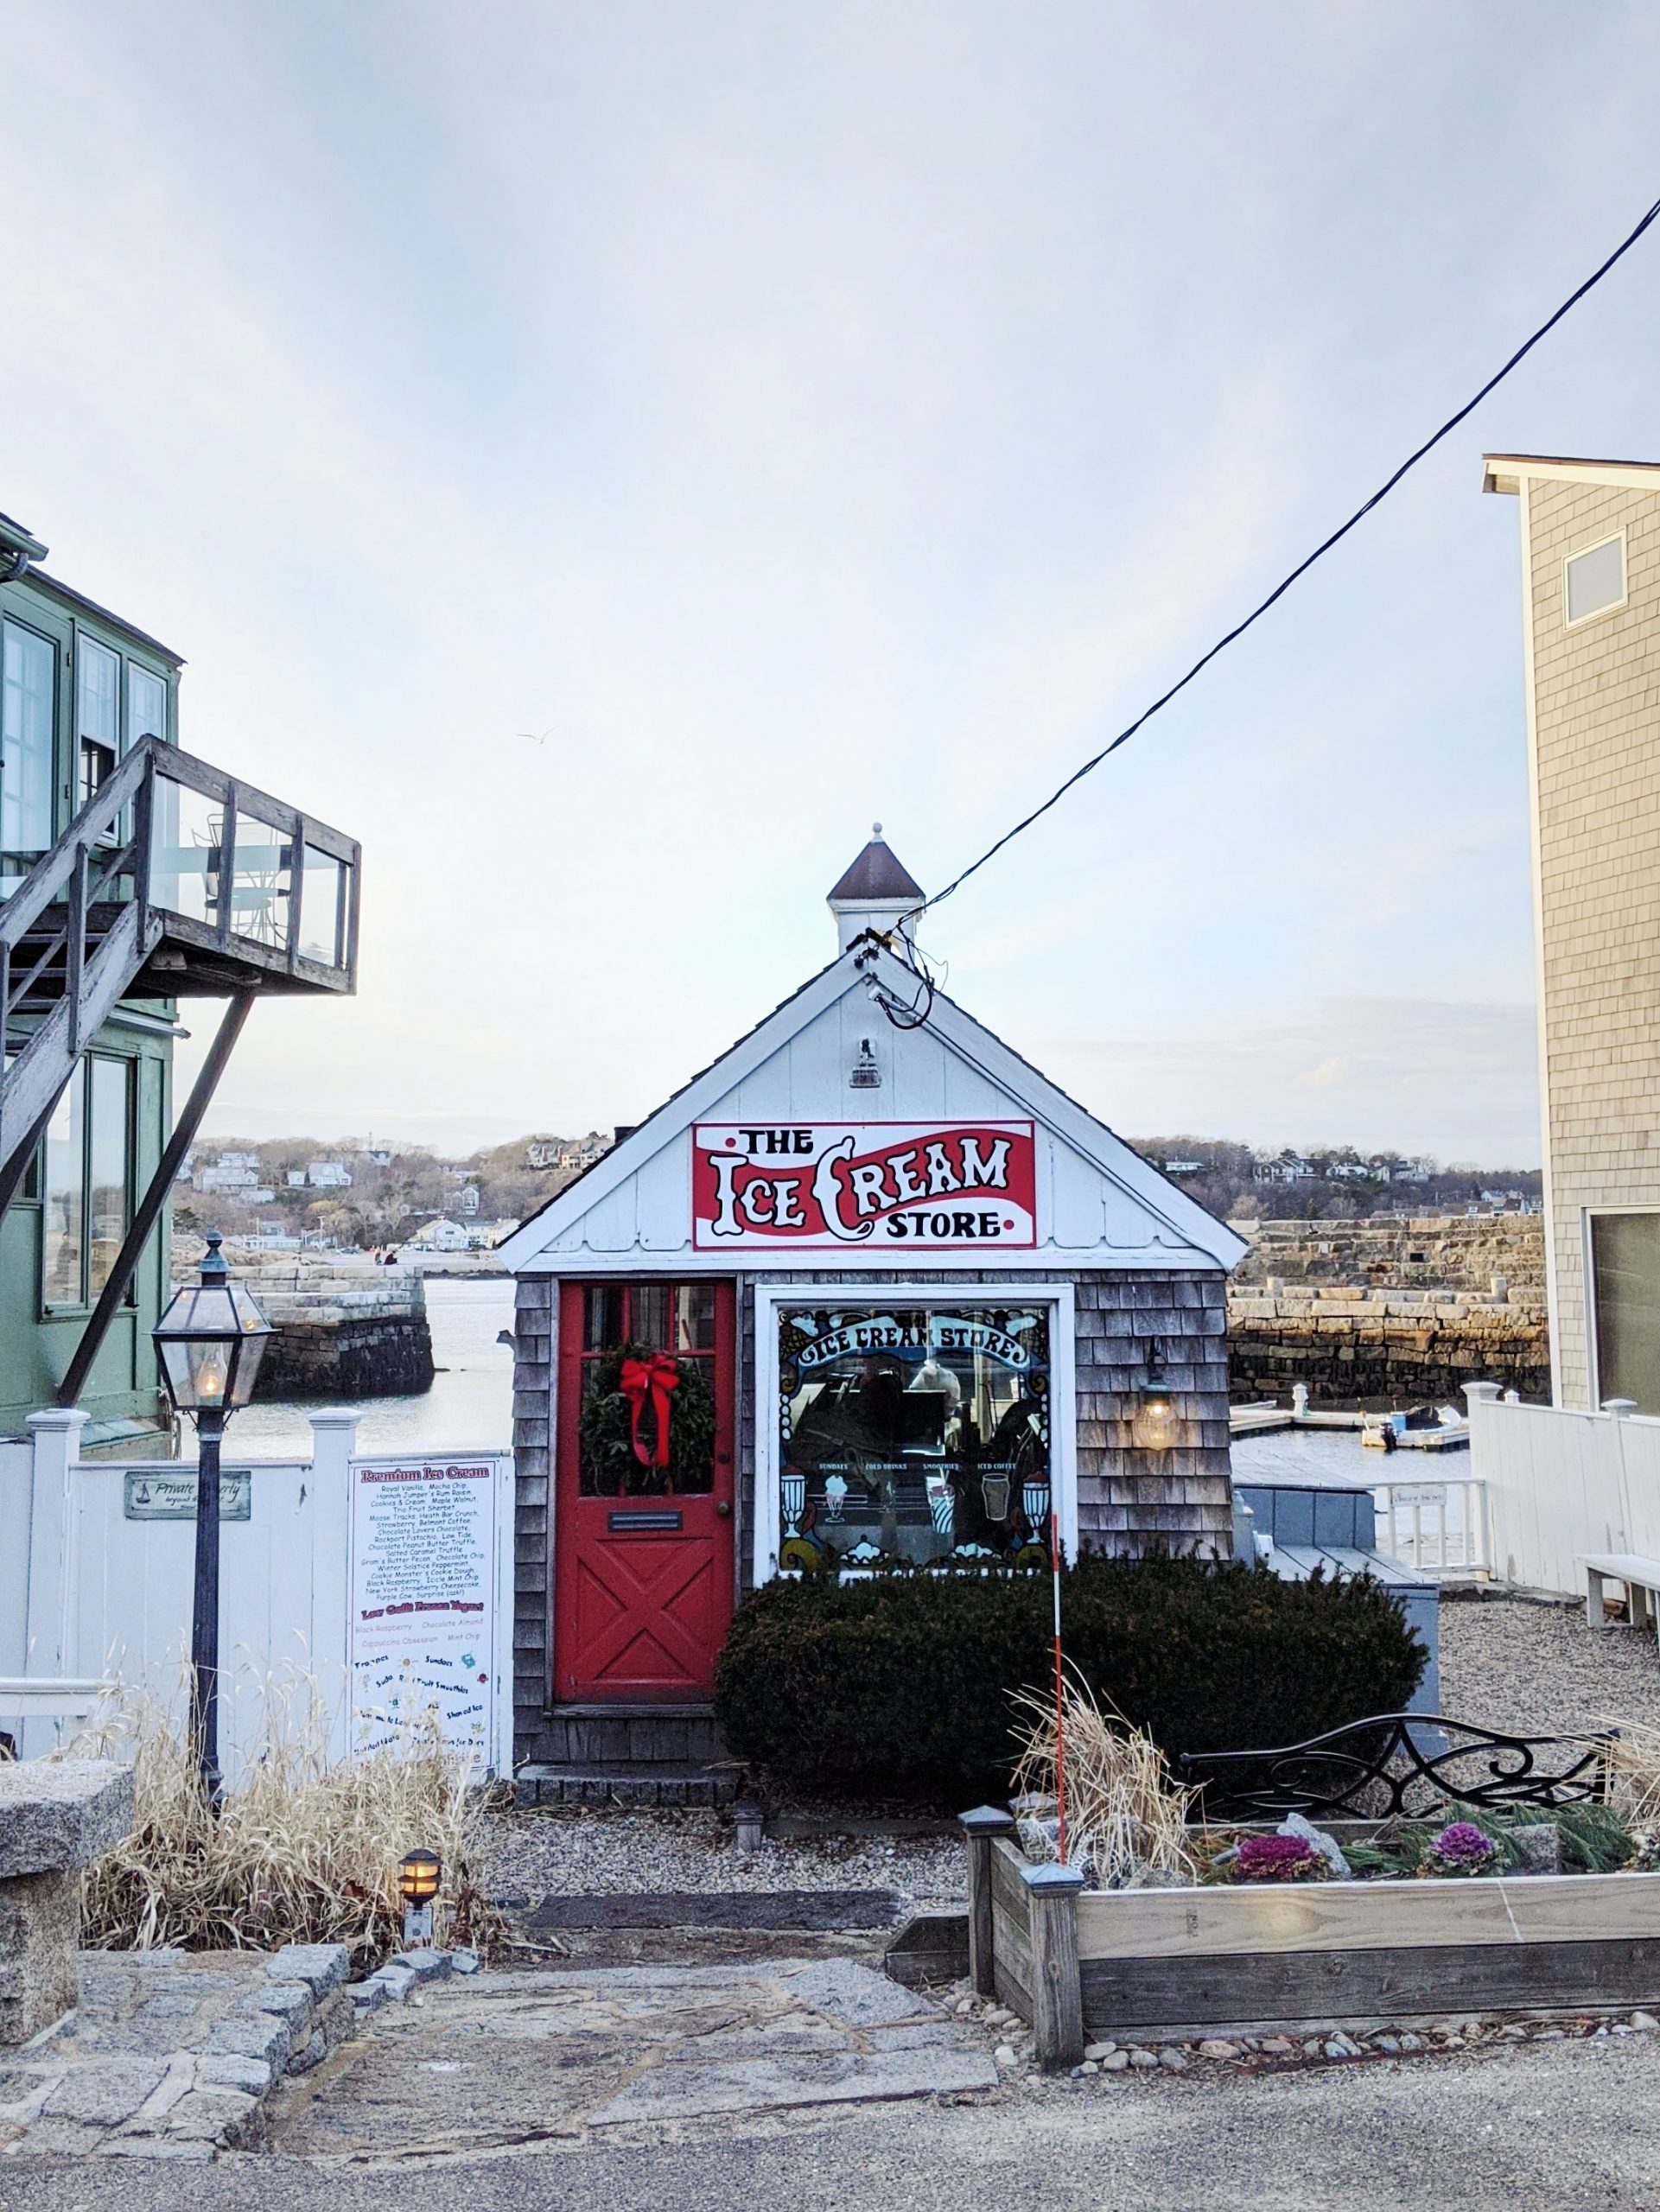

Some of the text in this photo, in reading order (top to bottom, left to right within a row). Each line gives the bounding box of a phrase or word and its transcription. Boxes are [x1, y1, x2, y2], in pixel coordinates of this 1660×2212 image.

[738, 1129, 814, 1155] THE
[887, 1211, 1002, 1238] STORE
[812, 1327, 1016, 1361] ICE CREAM STORE
[360, 1465, 490, 1484] Premium Ice Cream
[156, 1482, 195, 1495] Private
[381, 1484, 400, 1492] Royal
[378, 1528, 410, 1536] Chocolate
[400, 1584, 439, 1592] Strawberry
[417, 1591, 445, 1599] Surprise
[354, 1618, 484, 1634] Black Raspberry Chocolate Almond
[447, 1633, 464, 1642] Mint
[465, 1632, 480, 1642] Chip
